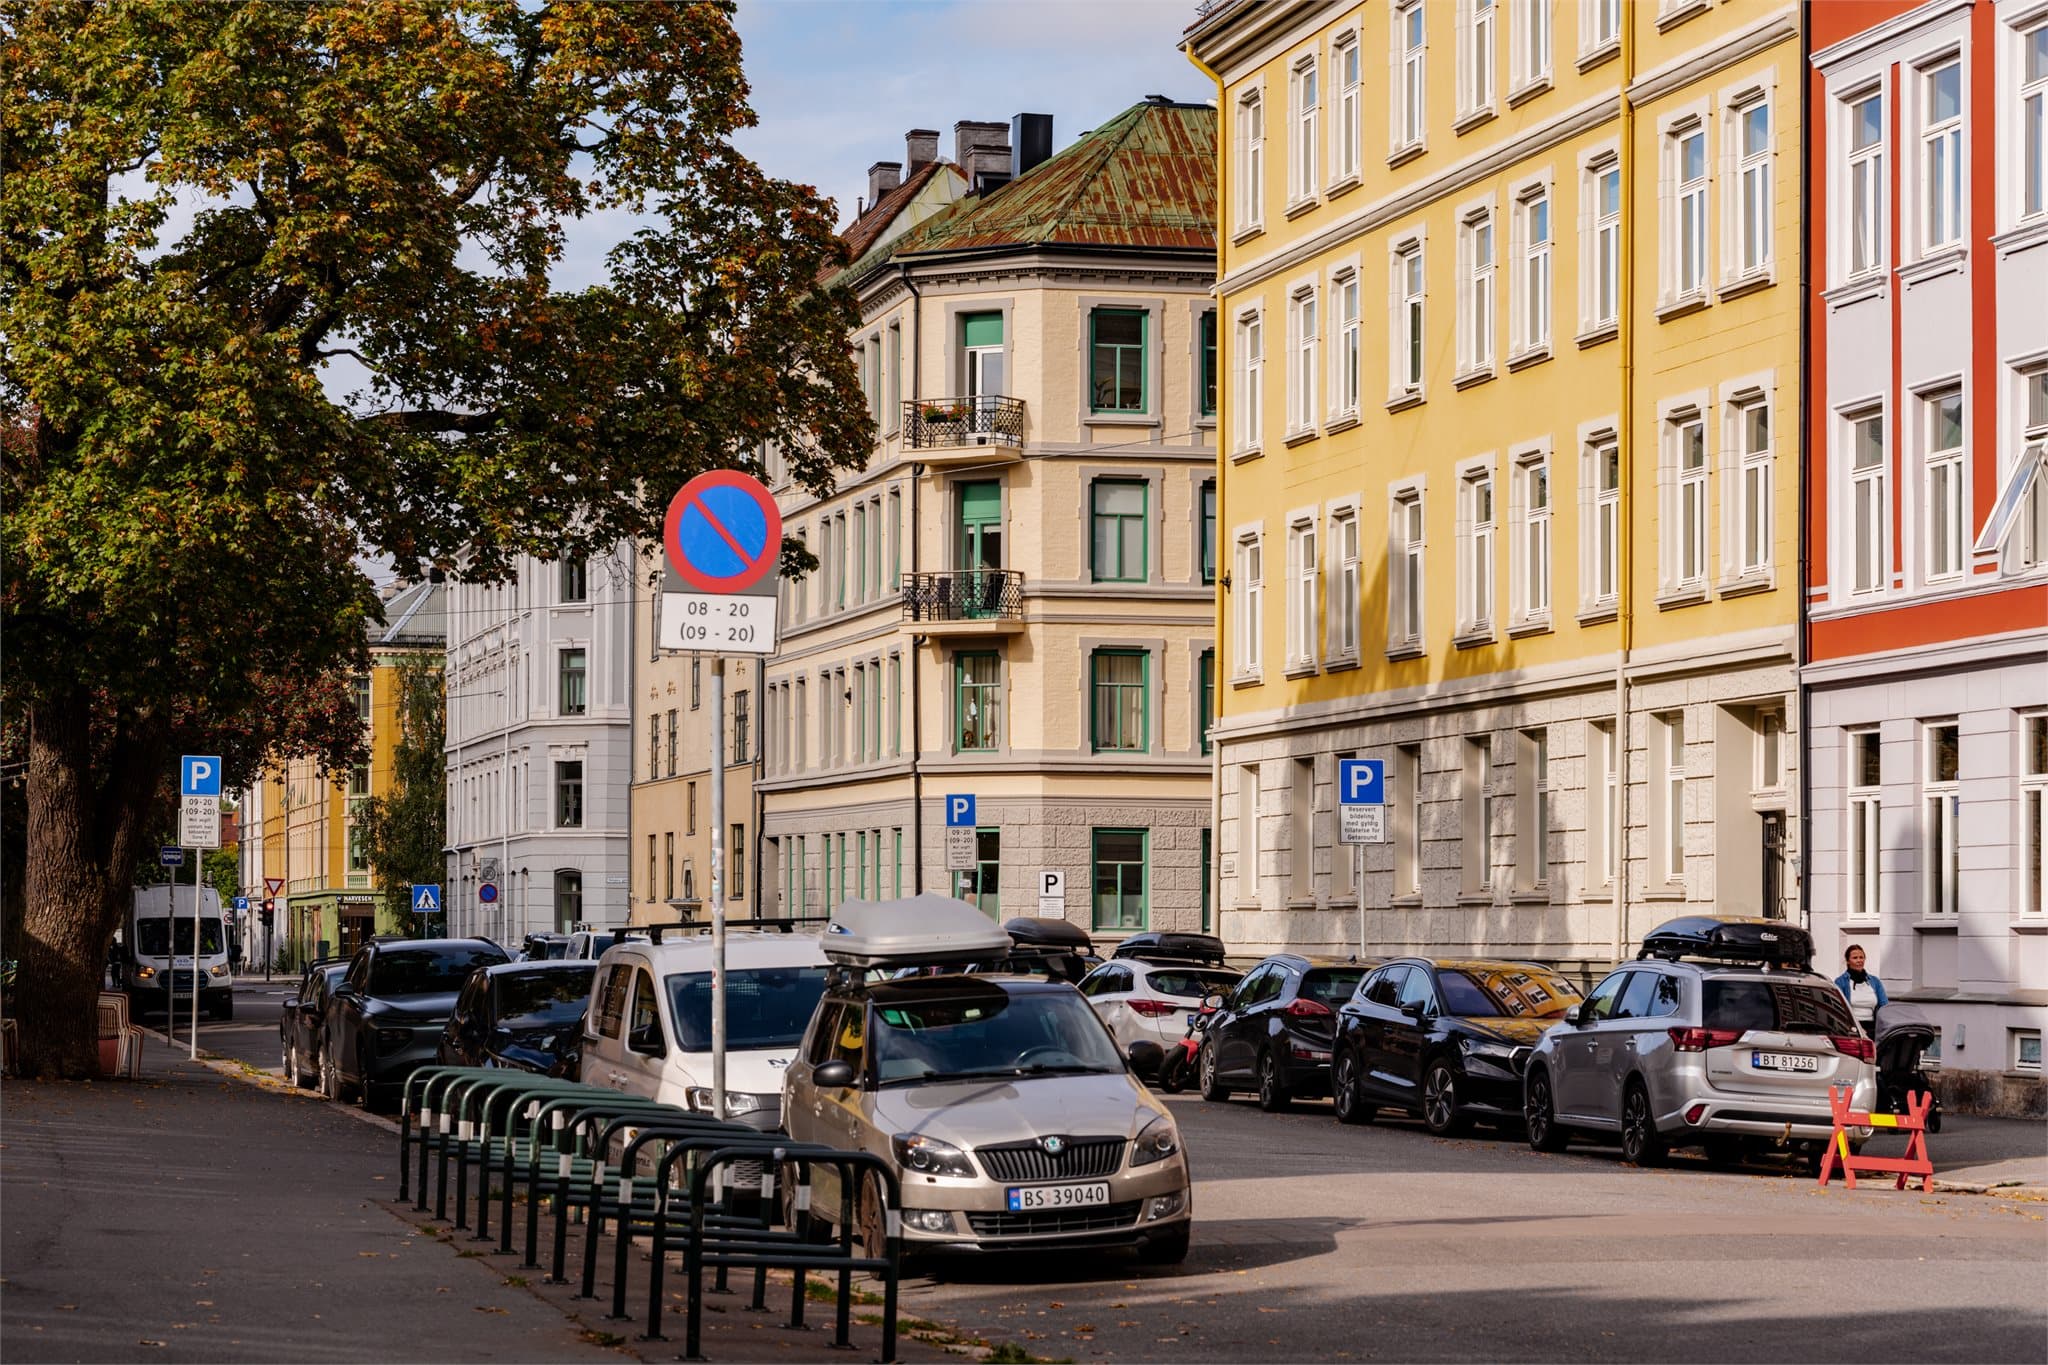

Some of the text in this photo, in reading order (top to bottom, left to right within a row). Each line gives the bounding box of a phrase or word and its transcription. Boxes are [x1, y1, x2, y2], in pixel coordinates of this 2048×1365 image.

[688, 601, 708, 616] 08
[729, 603, 750, 617] 20
[680, 622, 707, 641] (09
[728, 624, 755, 643] 20)
[191, 761, 211, 790] P
[1351, 765, 1374, 798] P
[953, 798, 969, 823] P
[1350, 813, 1375, 821] bildeling
[1045, 874, 1058, 893] P
[238, 899, 246, 907] P
[1763, 1055, 1814, 1068] BT 81256
[1024, 1186, 1104, 1207] BS 39040
